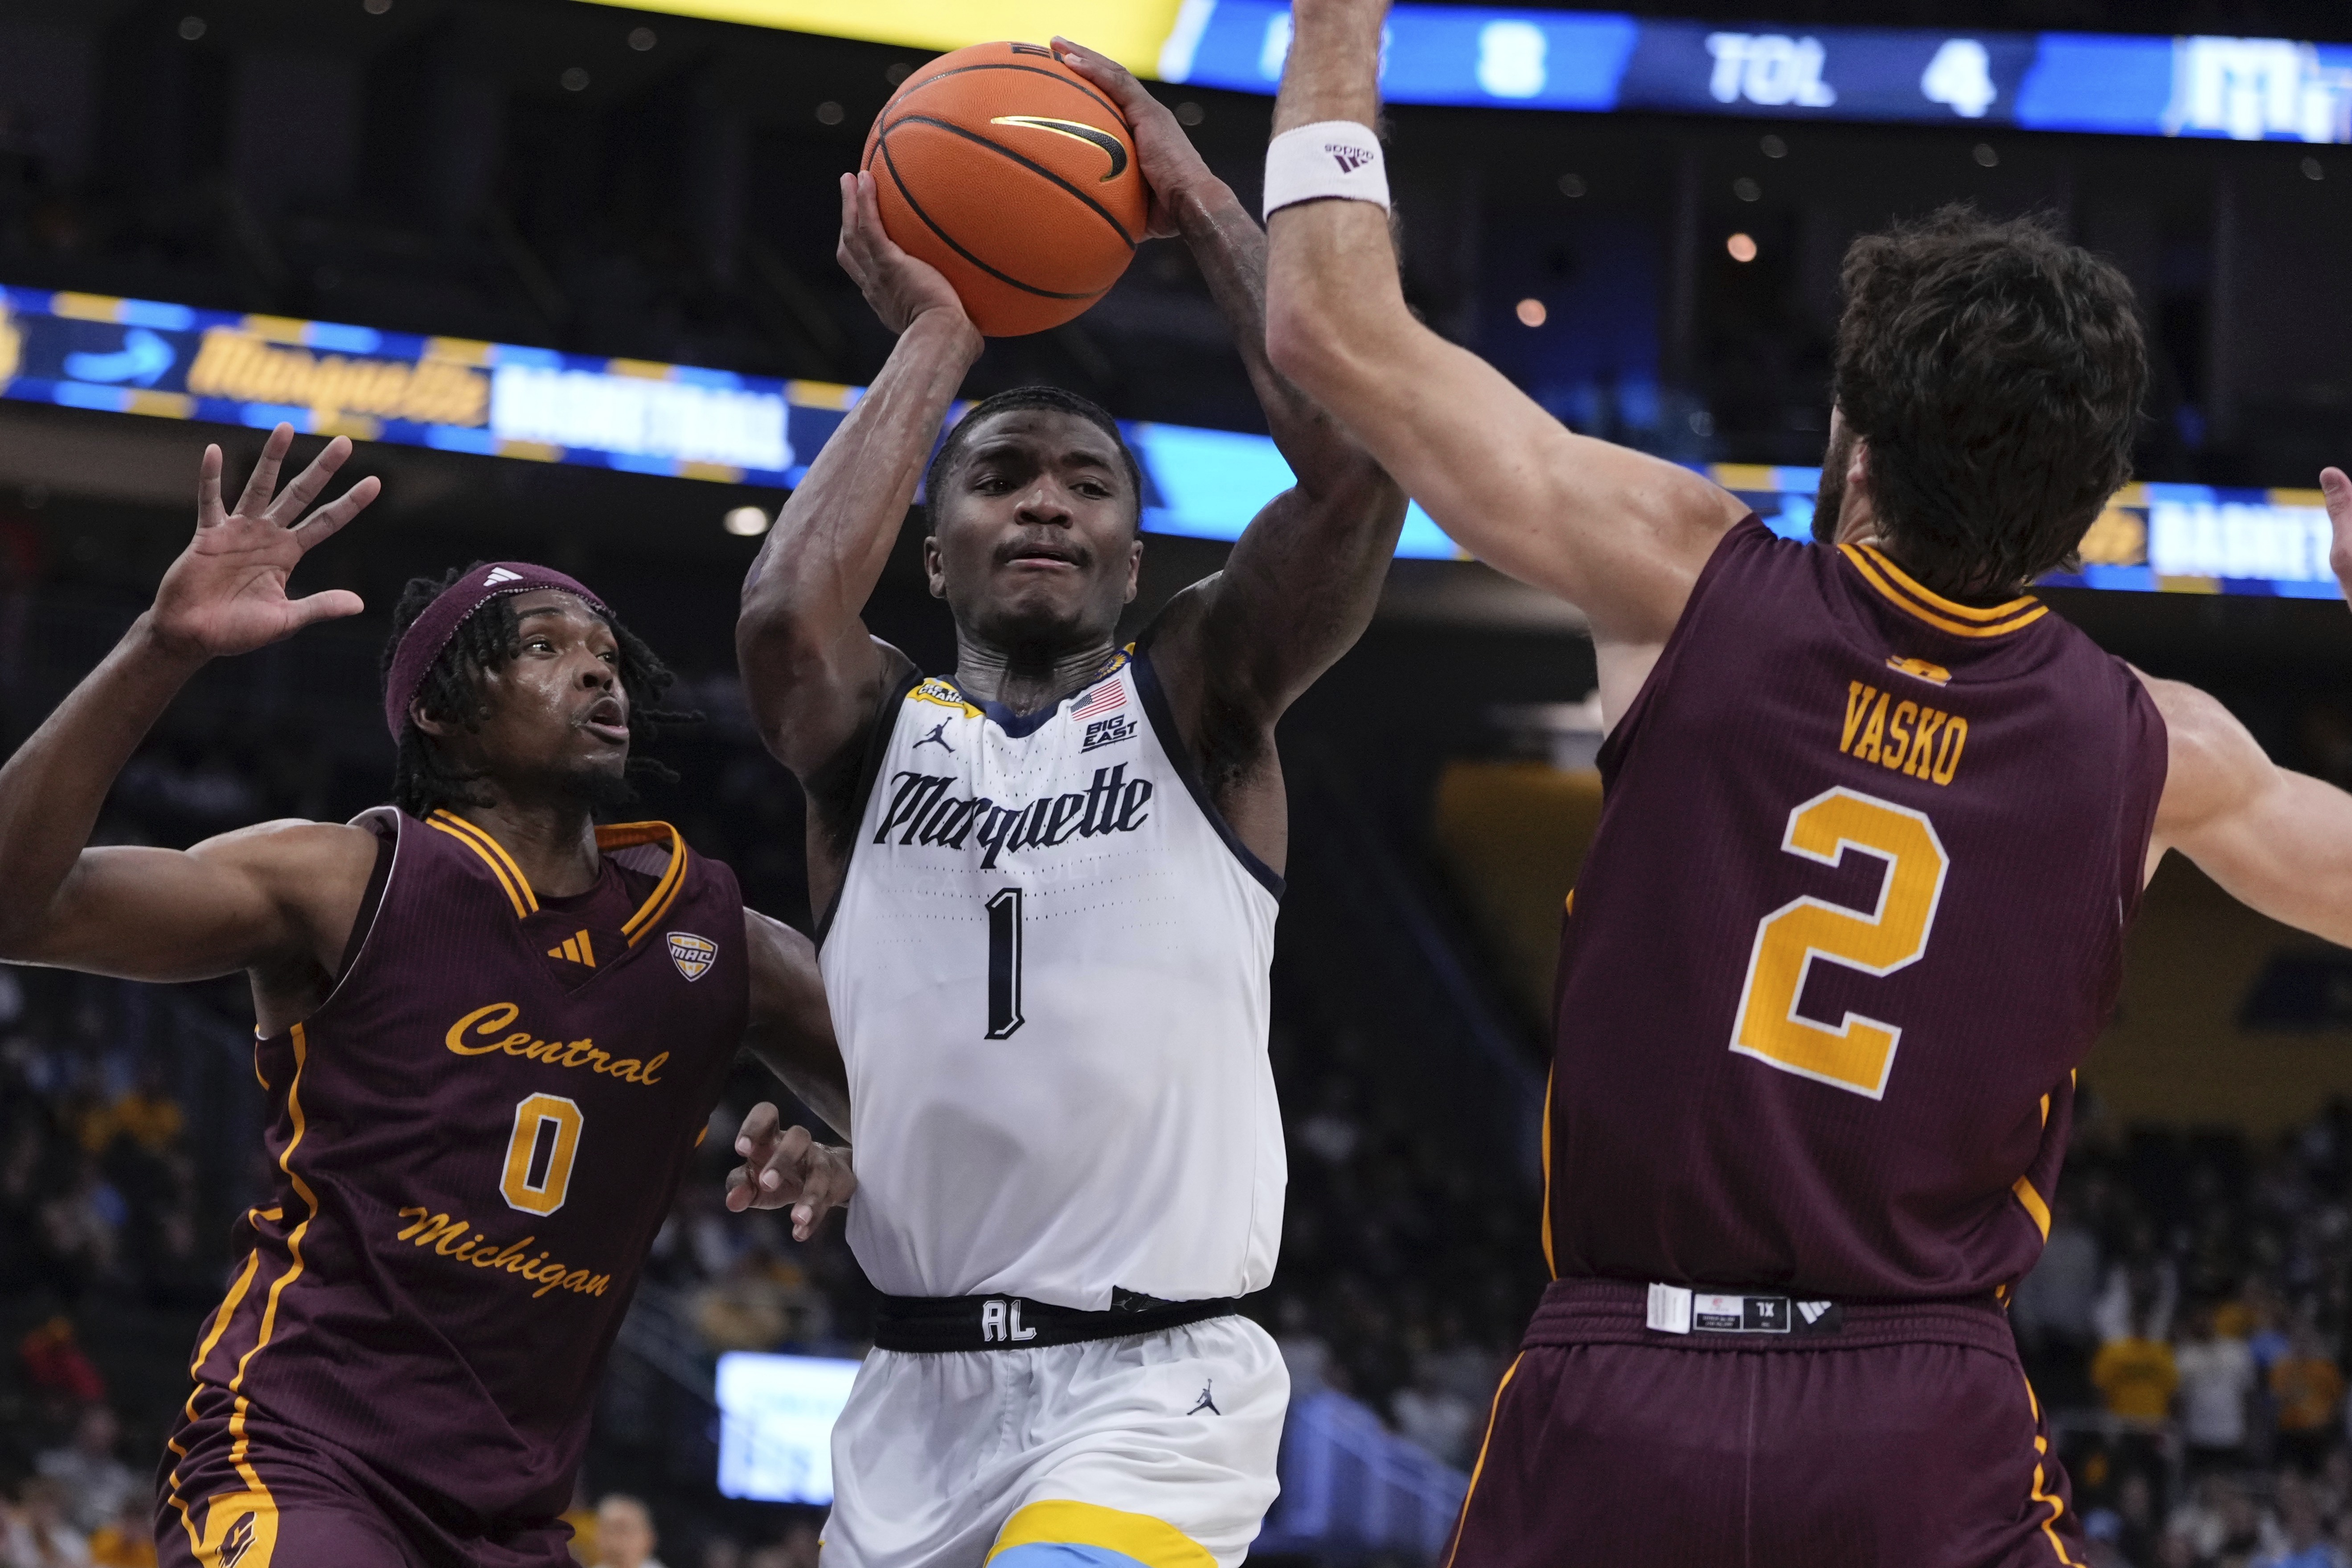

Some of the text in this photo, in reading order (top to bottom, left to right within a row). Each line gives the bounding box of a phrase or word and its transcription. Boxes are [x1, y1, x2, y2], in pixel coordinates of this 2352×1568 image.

[1476, 19, 1548, 98] 8
[1705, 32, 1997, 118] TOL 4
[1324, 143, 1373, 160] adidas
[1083, 721, 1137, 747] EAST
[1086, 713, 1125, 736] BIG
[1839, 681, 1968, 786] VASKO
[873, 761, 1153, 869] Marquette
[672, 945, 712, 964] MAC
[984, 888, 1025, 1040] 1
[1729, 785, 1950, 1101] 2
[445, 1002, 669, 1085] Central
[499, 1092, 584, 1217] 0
[397, 1207, 612, 1298] Michigan
[982, 1299, 1037, 1342] AL
